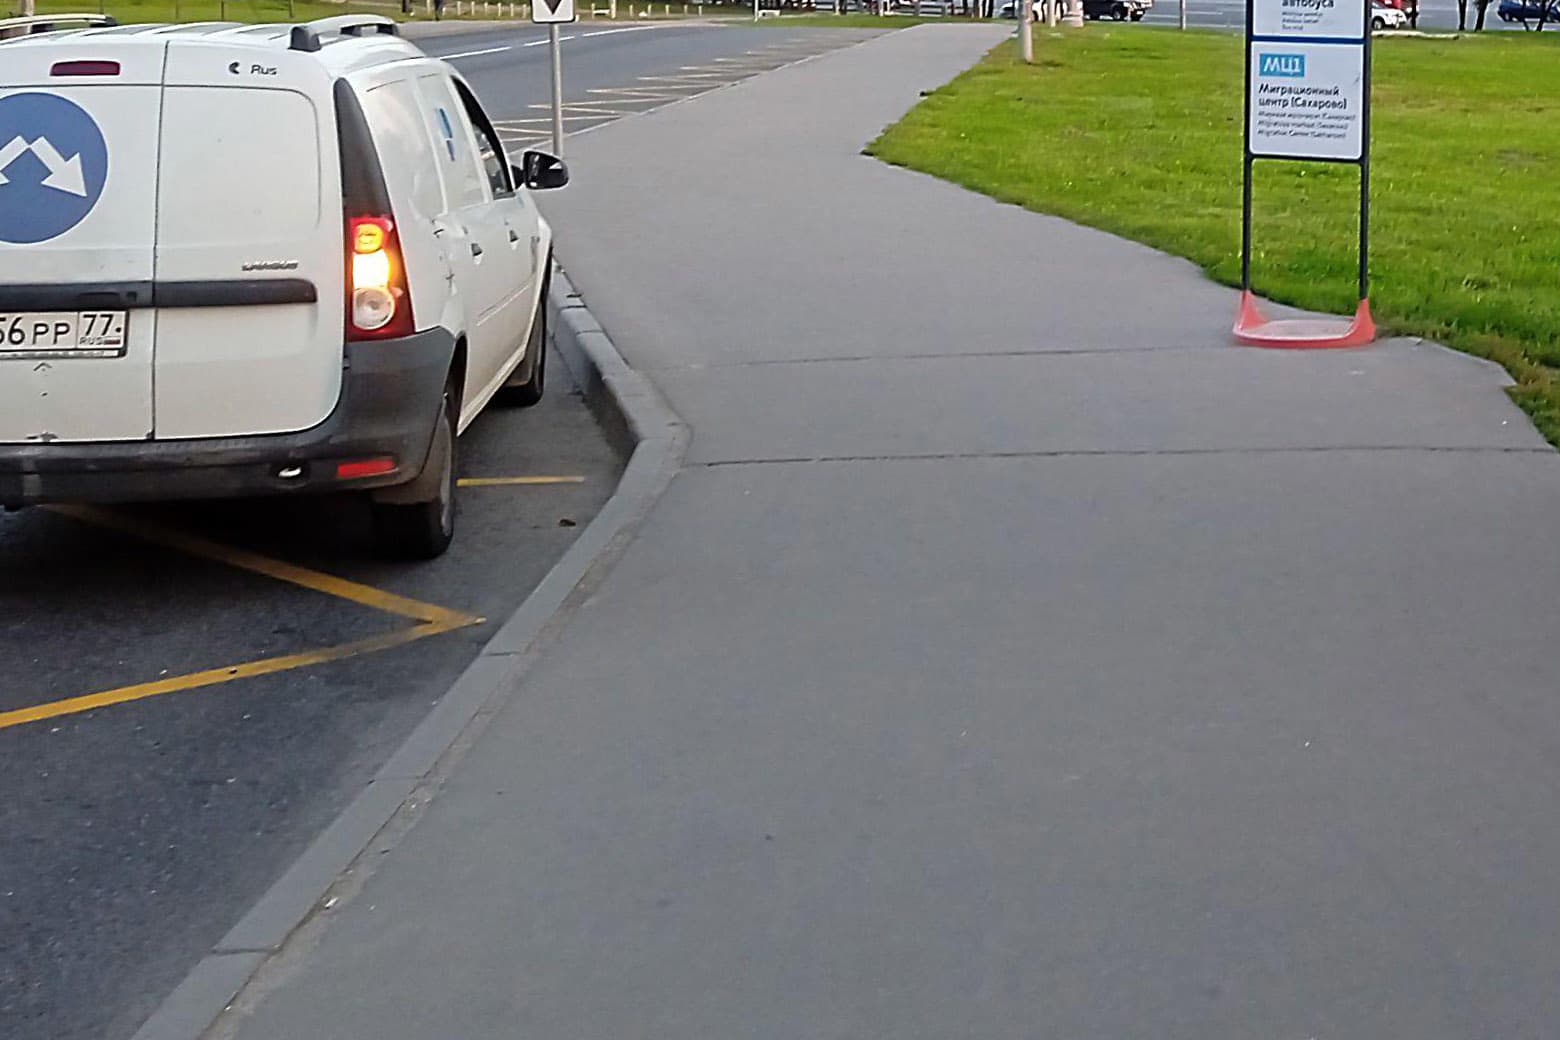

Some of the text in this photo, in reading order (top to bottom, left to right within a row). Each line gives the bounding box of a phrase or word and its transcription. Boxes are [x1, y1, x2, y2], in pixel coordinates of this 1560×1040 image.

[250, 64, 278, 75] Rus
[1258, 83, 1340, 96] Миграционный
[1258, 96, 1347, 110] центр (Сахарово)
[83, 314, 114, 336] 77
